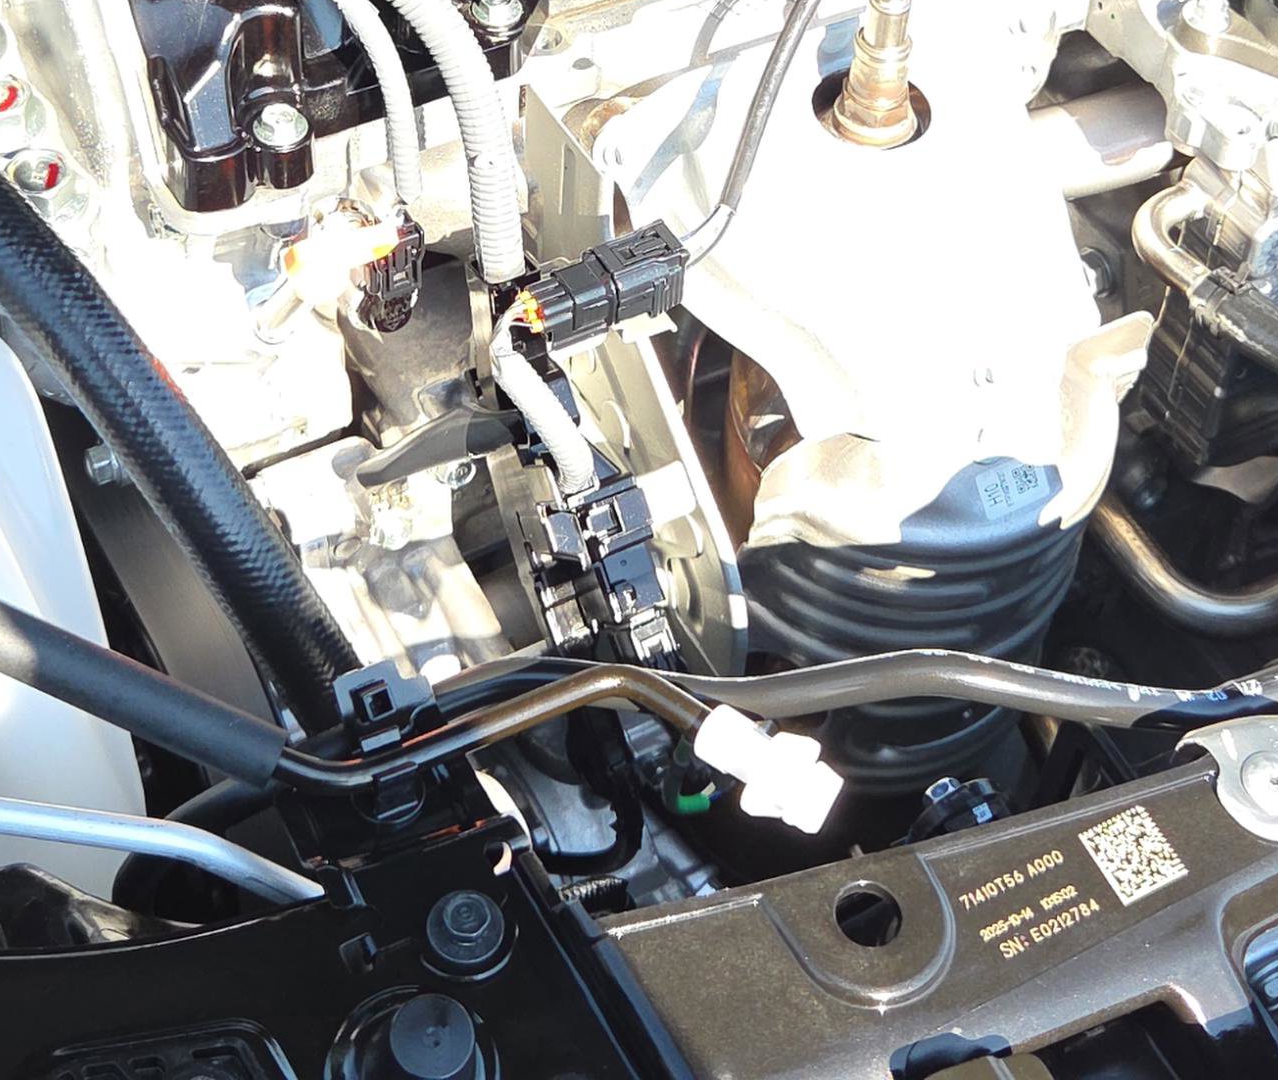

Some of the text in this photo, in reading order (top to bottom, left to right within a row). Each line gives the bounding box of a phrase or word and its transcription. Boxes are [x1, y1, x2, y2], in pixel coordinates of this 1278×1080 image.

[958, 850, 1065, 911] 71410T56 A000
[979, 906, 1036, 942] 2025-10-14
[998, 897, 1101, 960] SN: E0212784
